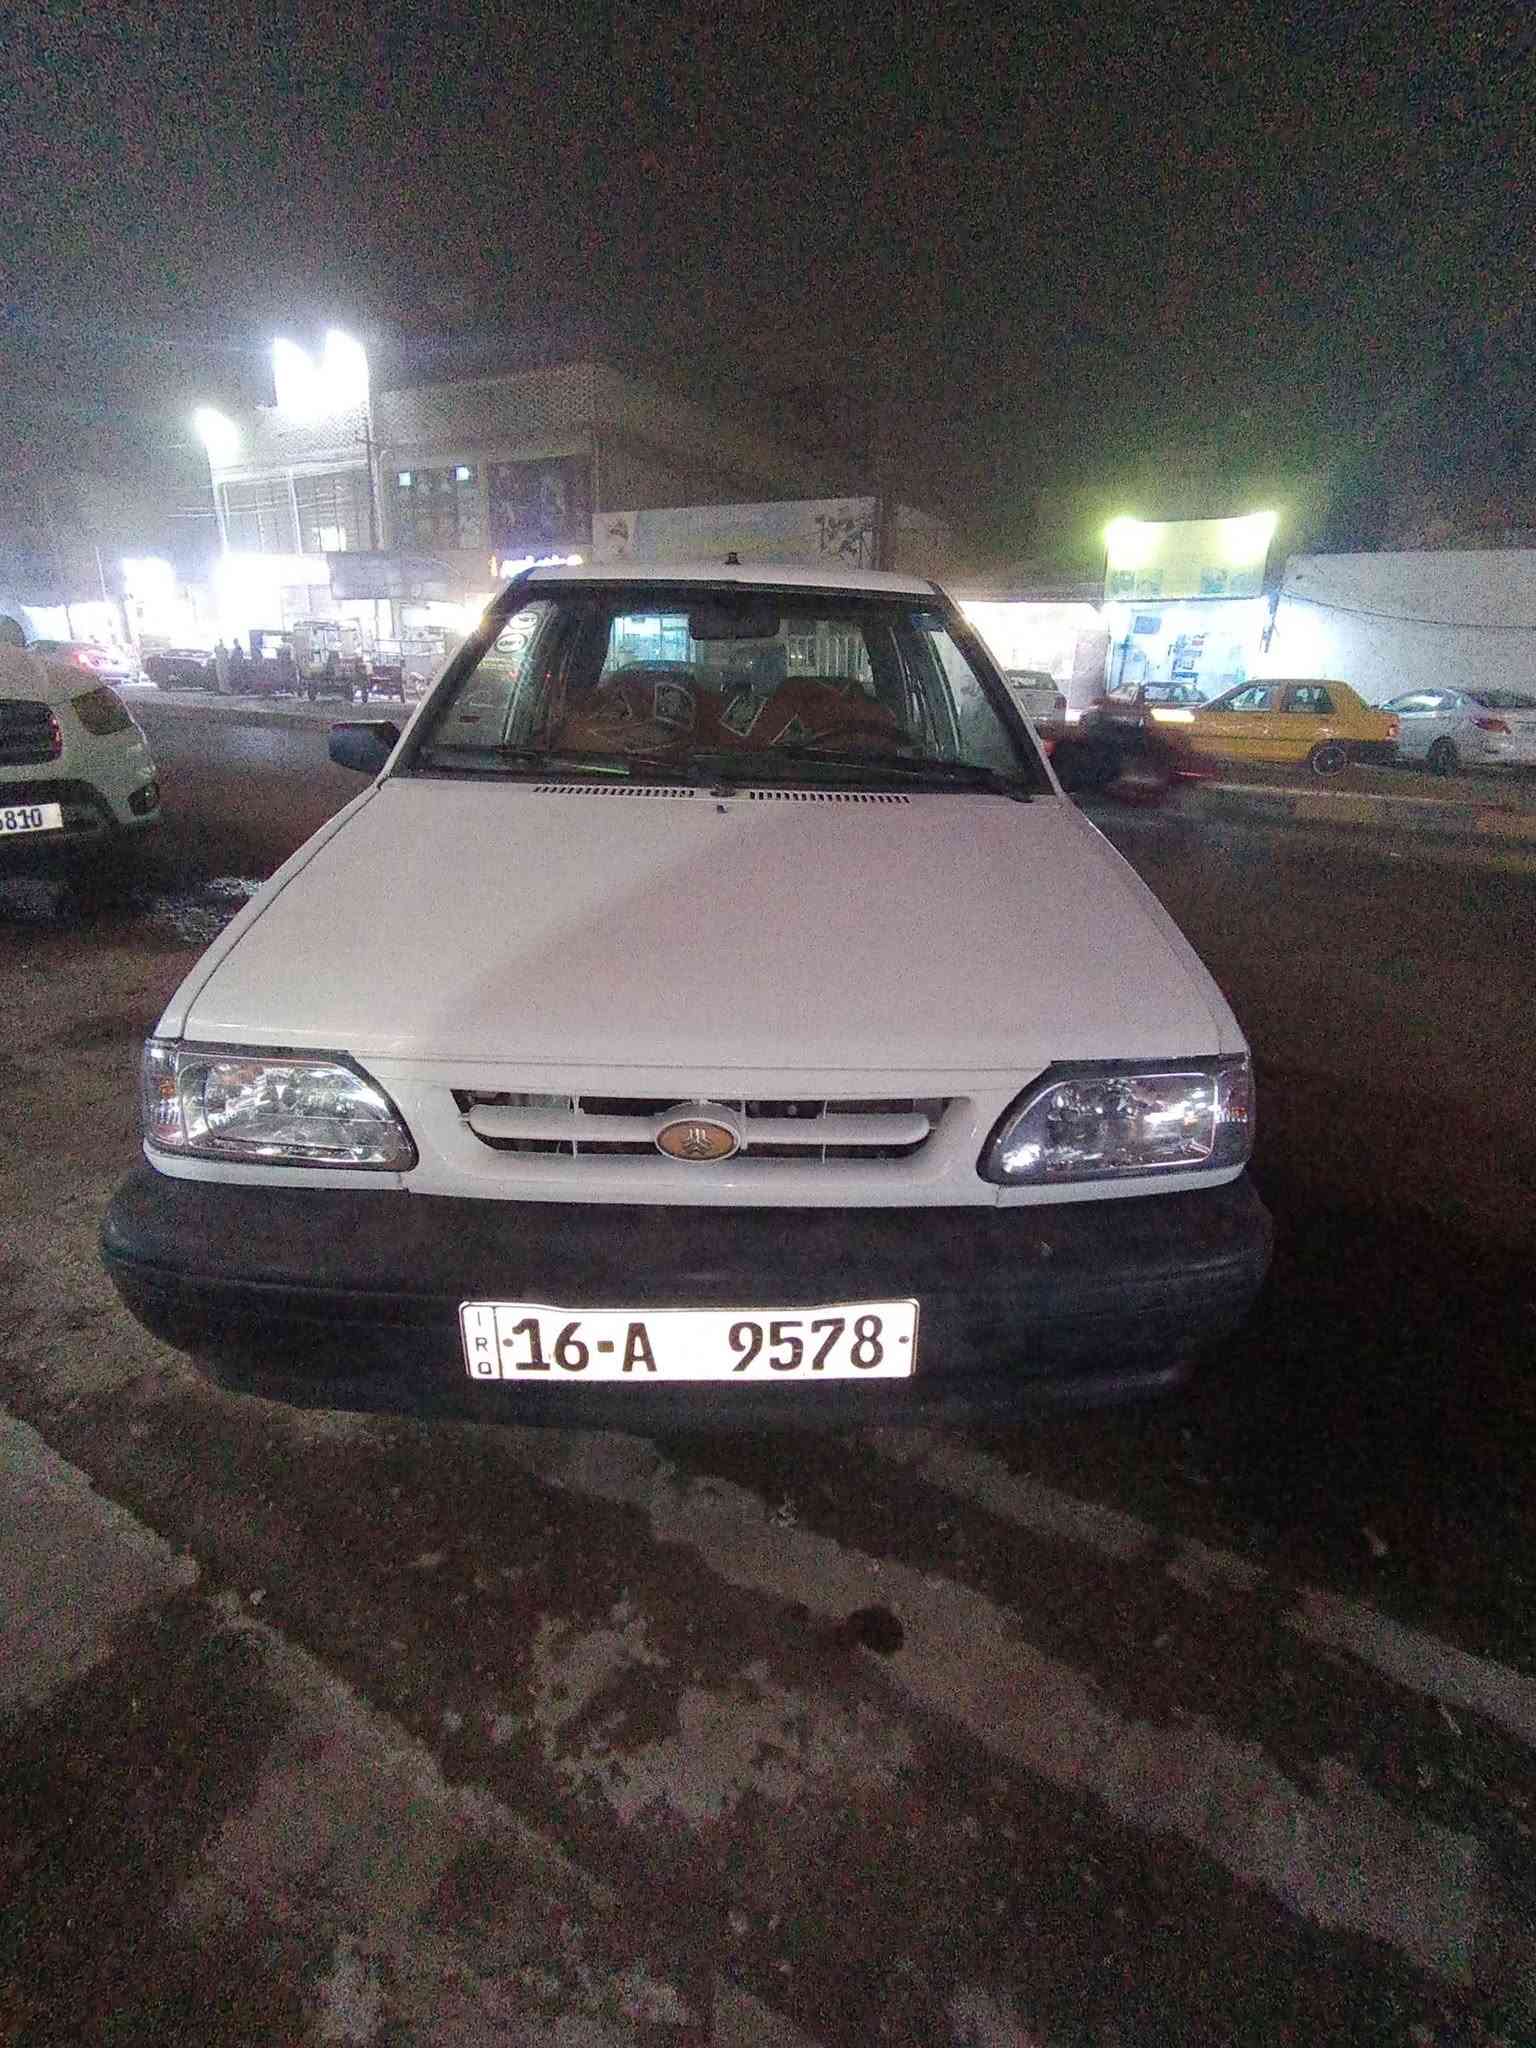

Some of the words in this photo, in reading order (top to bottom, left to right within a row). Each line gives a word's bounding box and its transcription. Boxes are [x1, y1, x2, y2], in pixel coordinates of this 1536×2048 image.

[0, 807, 42, 830] 810
[475, 1311, 492, 1375] IRQ
[728, 1314, 884, 1373] 9578
